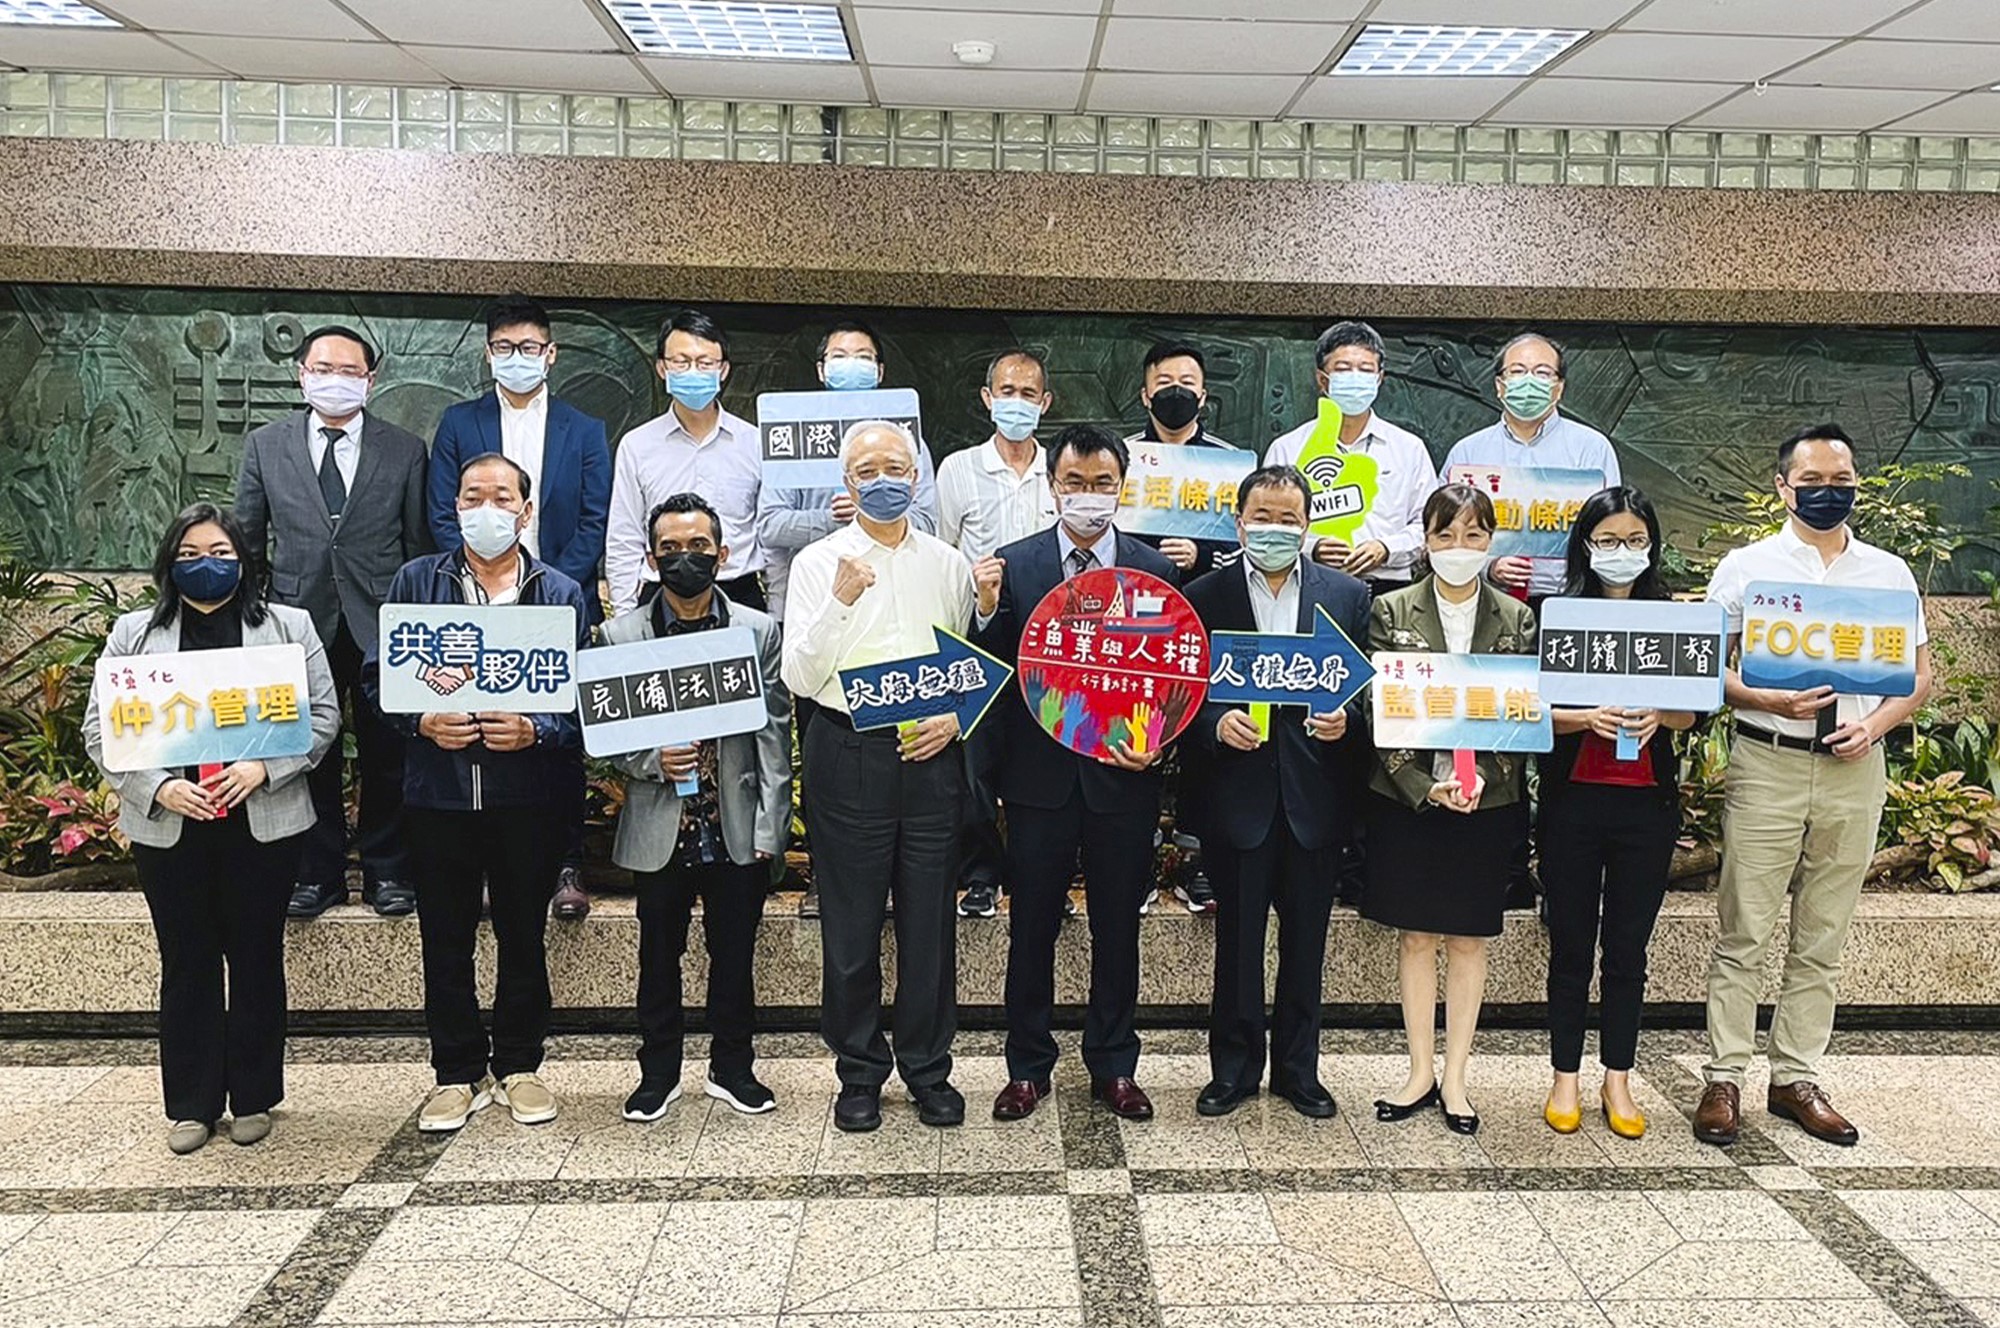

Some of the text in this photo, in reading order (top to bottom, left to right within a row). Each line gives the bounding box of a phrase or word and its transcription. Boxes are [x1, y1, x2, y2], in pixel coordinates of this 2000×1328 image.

[1313, 494, 1348, 513] WIFI
[1753, 593, 1803, 613] 加強
[389, 622, 570, 693] 共善夥伴
[1027, 617, 1202, 675] 漁業與人權
[1545, 633, 1714, 674] 持續監督
[1745, 619, 1906, 664] FOC管理
[110, 667, 174, 690] 強化
[591, 660, 756, 719] 完備法制
[846, 657, 987, 711] 大海無疆
[1209, 652, 1349, 693] 人權無界
[1383, 660, 1434, 680] 提升
[110, 683, 299, 738] 仲介管理
[1382, 684, 1542, 723] 監管量能
